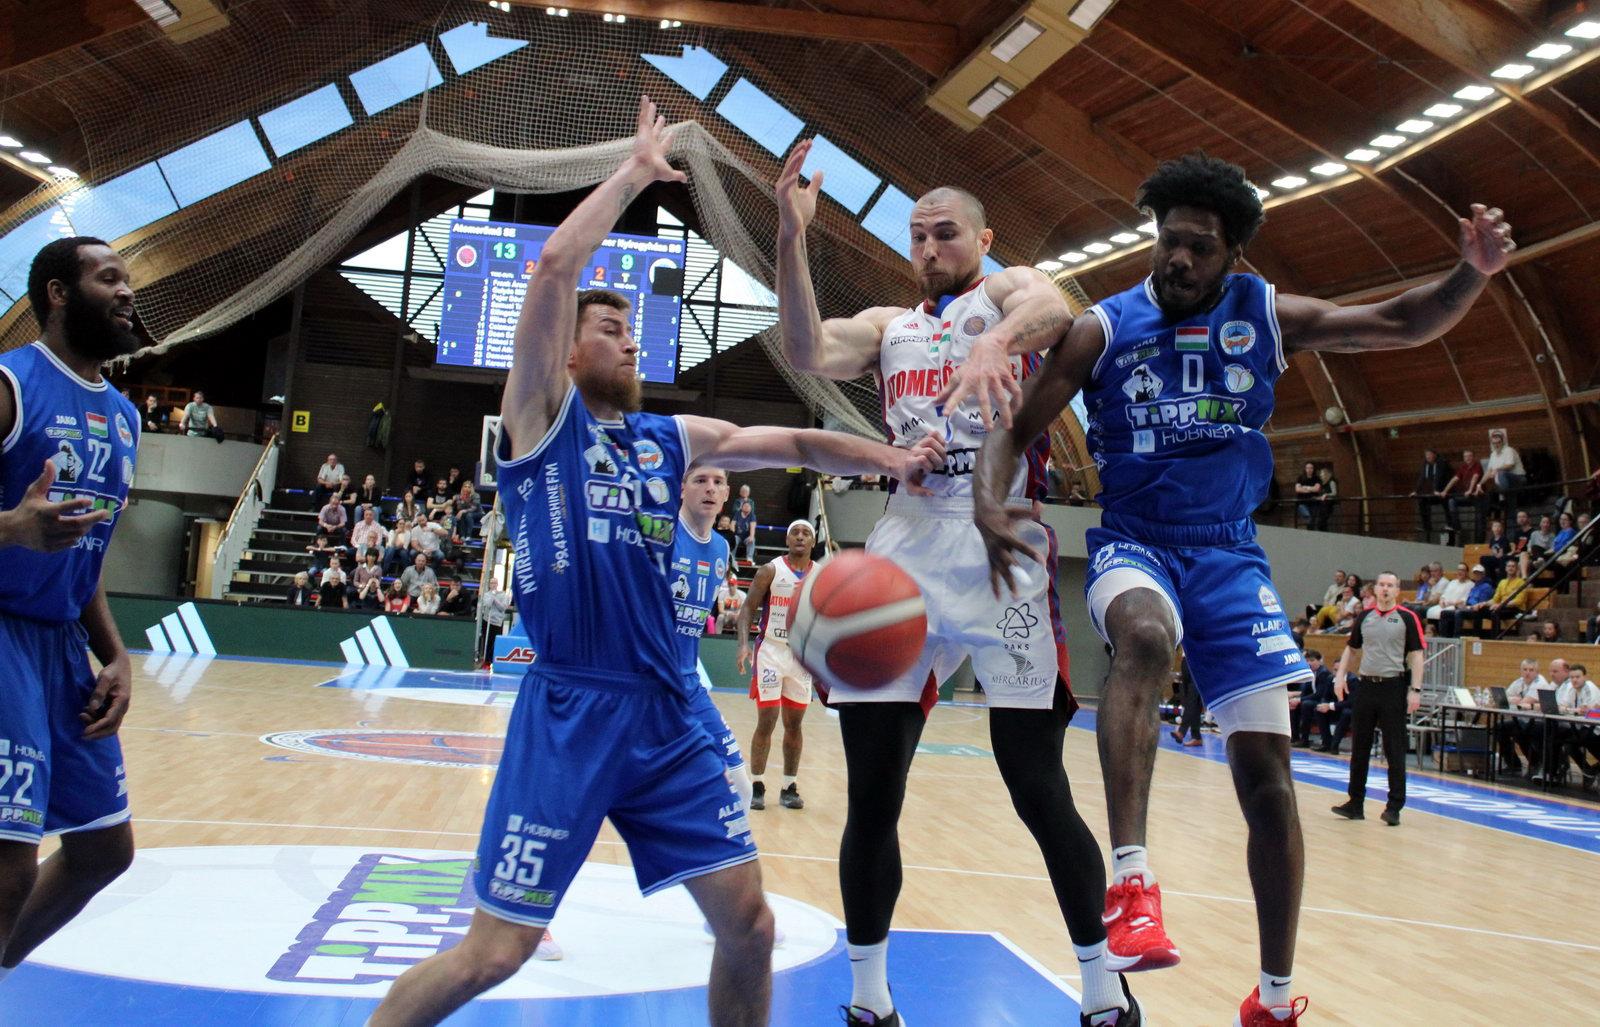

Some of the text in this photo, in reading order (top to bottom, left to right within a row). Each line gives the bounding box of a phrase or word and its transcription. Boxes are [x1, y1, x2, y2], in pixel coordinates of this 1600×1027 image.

[493, 242, 516, 259] 13
[525, 261, 535, 273] 2
[621, 254, 634, 270] 9
[595, 267, 604, 280] 2
[1182, 354, 1204, 393] 0
[296, 415, 306, 425] B
[87, 438, 112, 483] 22
[698, 577, 707, 602] 11
[762, 669, 776, 683] 23
[494, 835, 547, 887] 35
